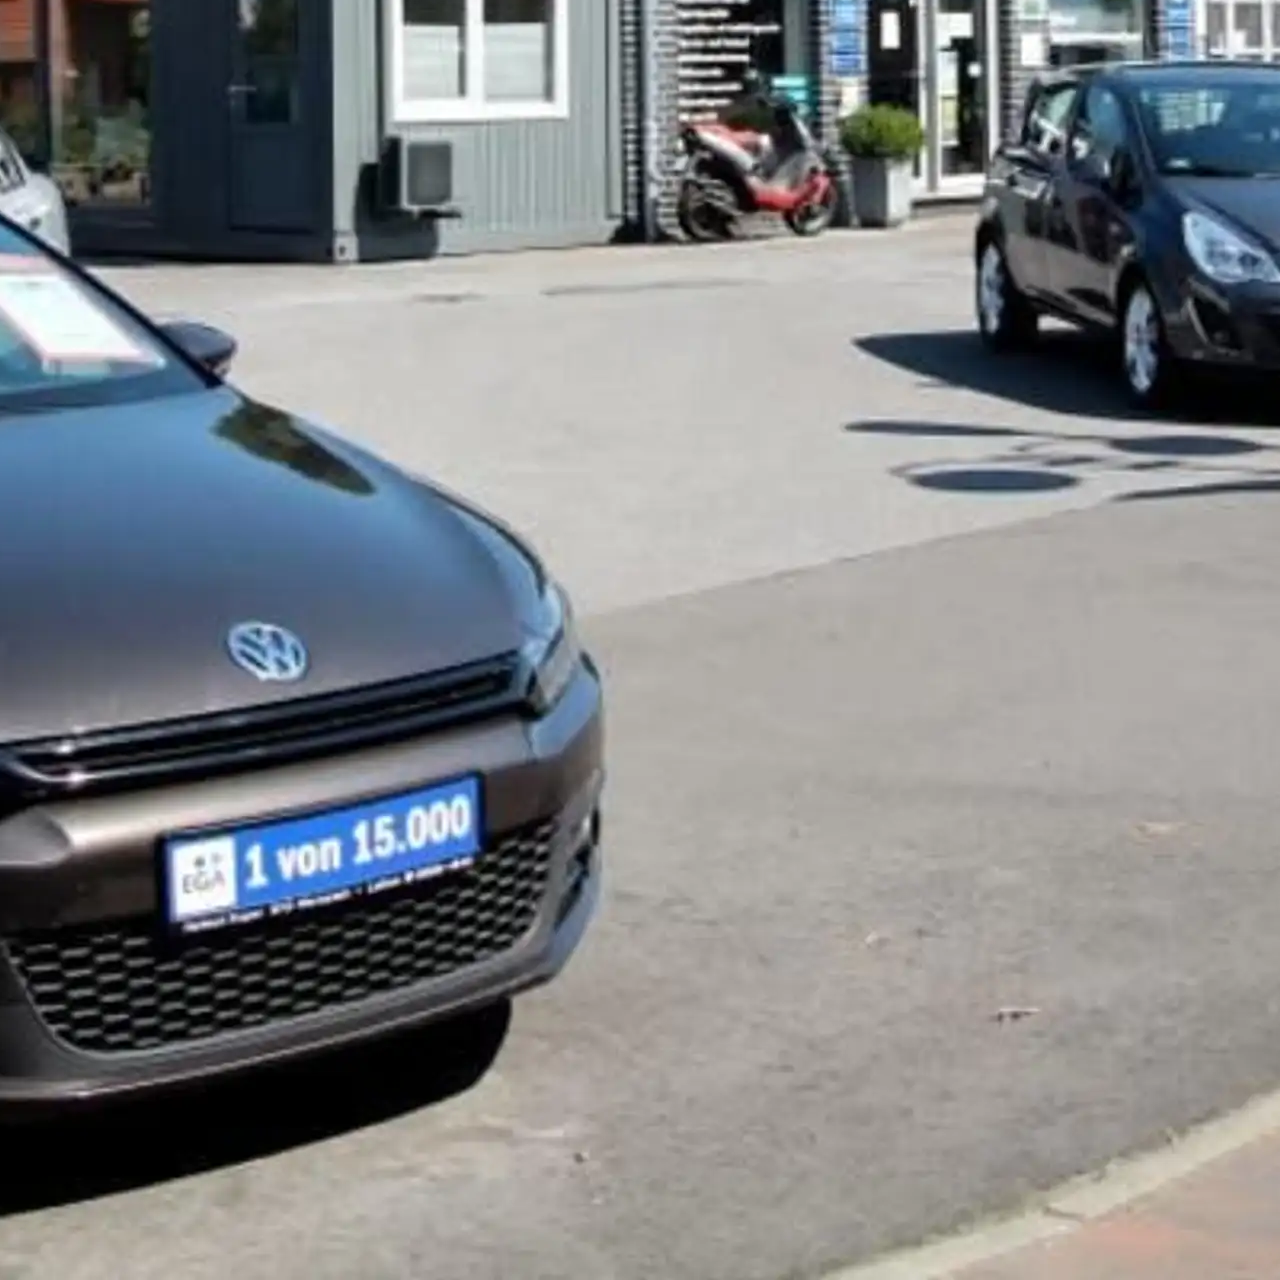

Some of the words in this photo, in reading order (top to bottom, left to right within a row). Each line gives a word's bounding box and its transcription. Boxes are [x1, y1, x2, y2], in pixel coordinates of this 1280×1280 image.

[244, 844, 269, 889] 1
[276, 838, 342, 882] von
[352, 793, 472, 865] 15.000
